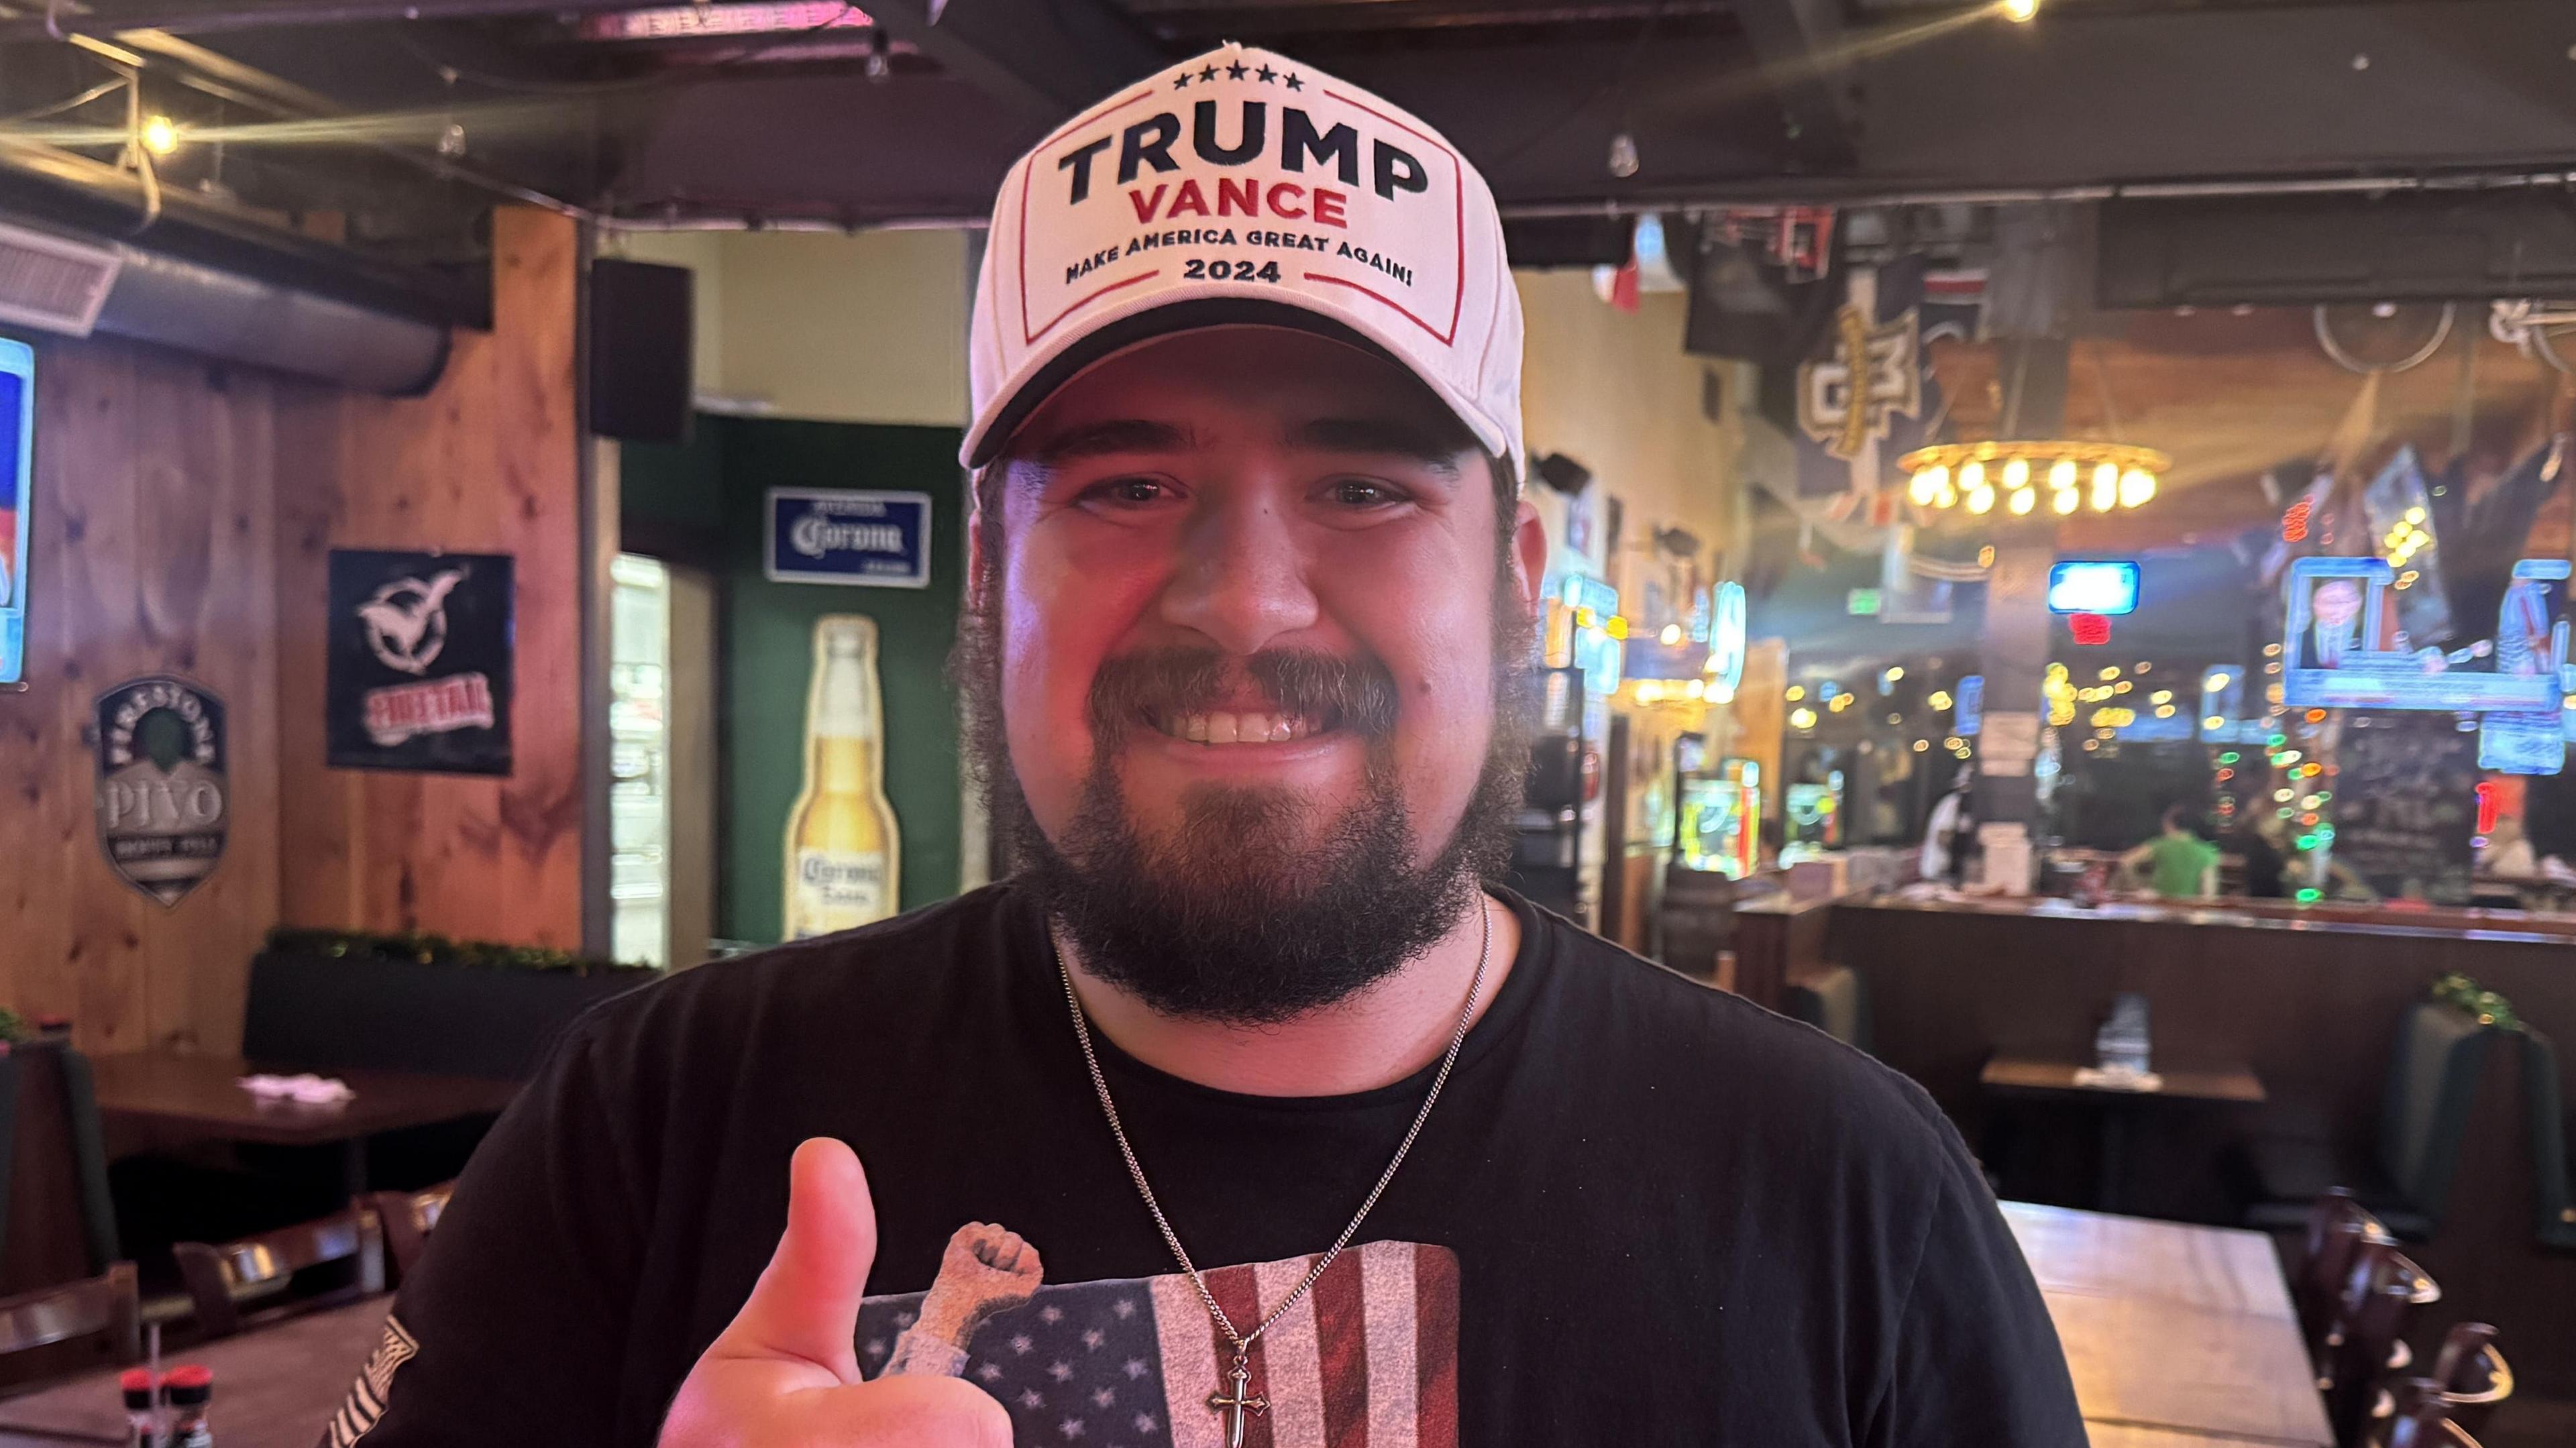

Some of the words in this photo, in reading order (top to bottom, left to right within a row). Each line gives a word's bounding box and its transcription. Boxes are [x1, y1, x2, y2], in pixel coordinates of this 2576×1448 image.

[1058, 100, 1429, 205] TRUMP
[1128, 178, 1348, 229] VANCE
[1065, 246, 1120, 284] MAKE
[1125, 228, 1238, 256] AMERICA
[1246, 230, 1330, 252] GREAT
[1336, 241, 1413, 287] AGAIN!
[1183, 259, 1282, 284] 2024
[791, 514, 906, 559] Corona
[106, 779, 223, 829] PIVO
